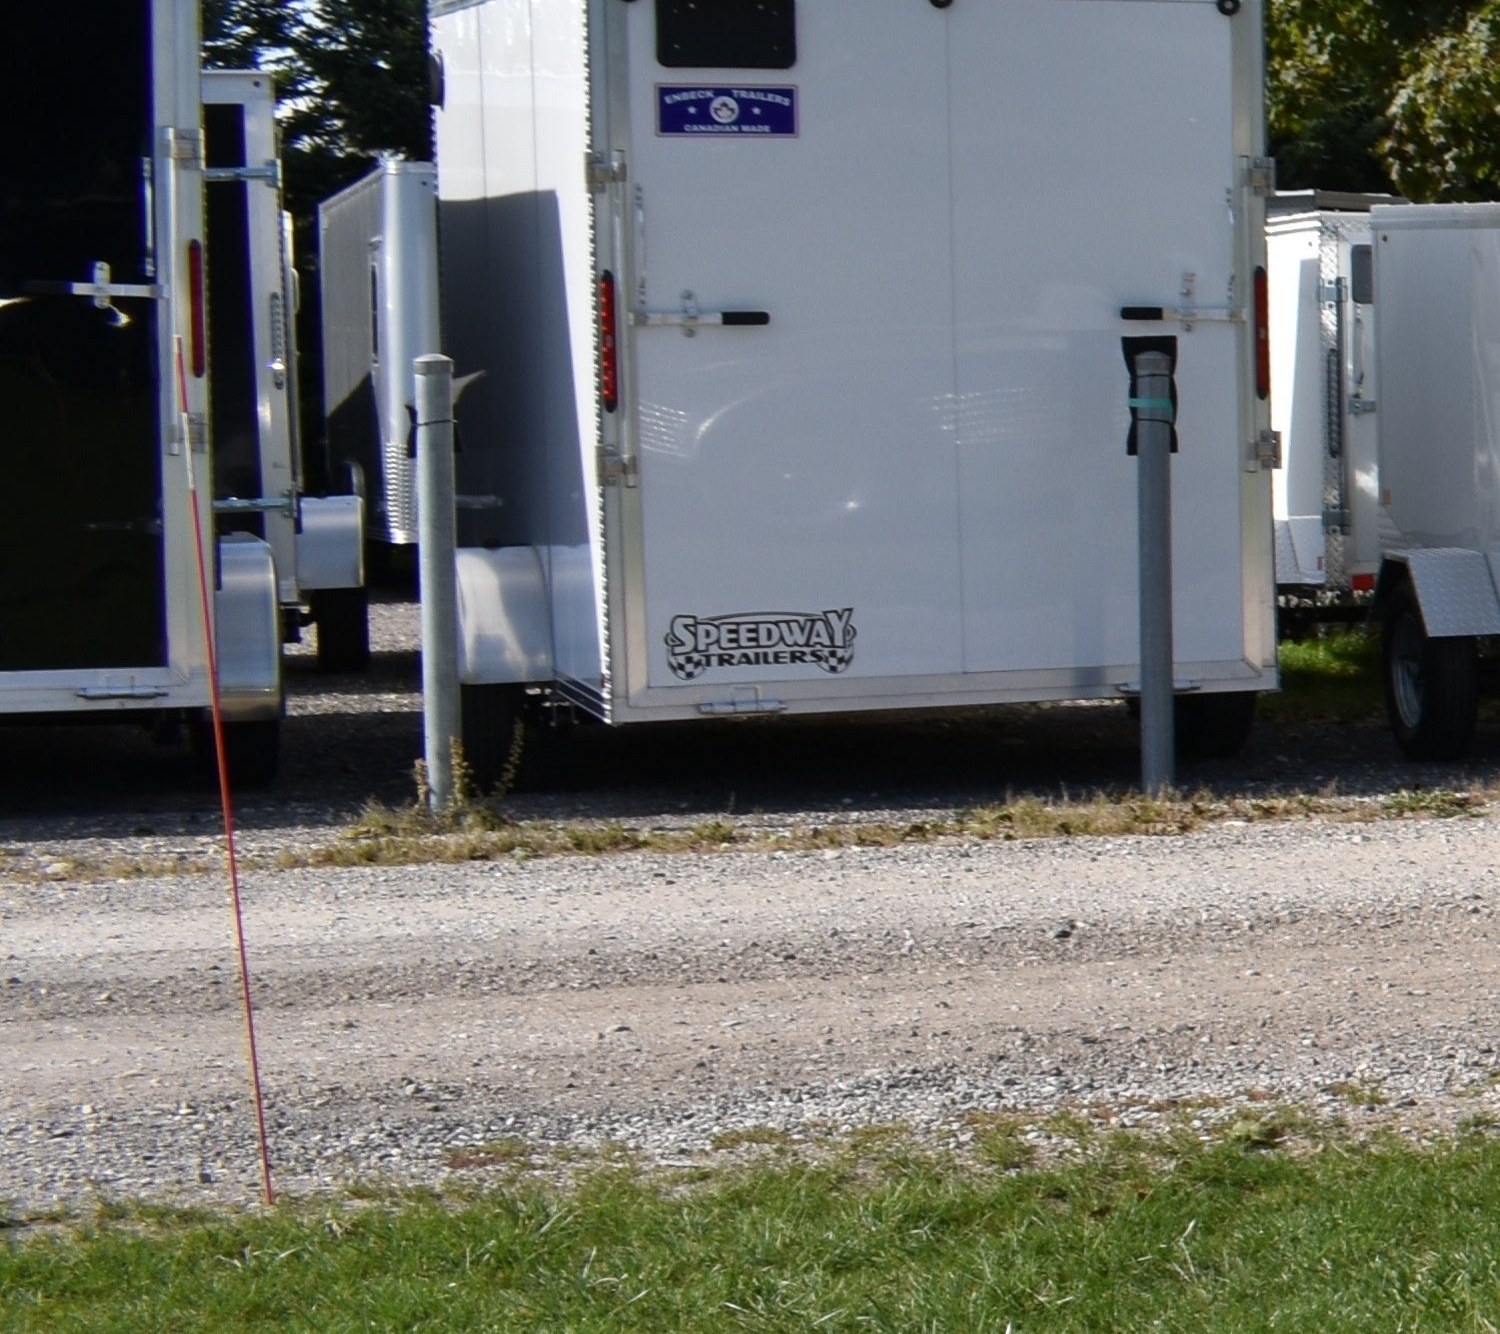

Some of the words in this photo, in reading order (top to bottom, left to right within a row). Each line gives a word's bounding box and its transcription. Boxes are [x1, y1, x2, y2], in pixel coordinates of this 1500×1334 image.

[664, 90, 714, 104] ENBECK
[731, 90, 791, 106] TRAILERS
[684, 124, 739, 132] CANADIAN
[741, 124, 771, 132] MADE
[670, 607, 854, 656] SPEEDWAY
[700, 649, 826, 668] TRAILERS
